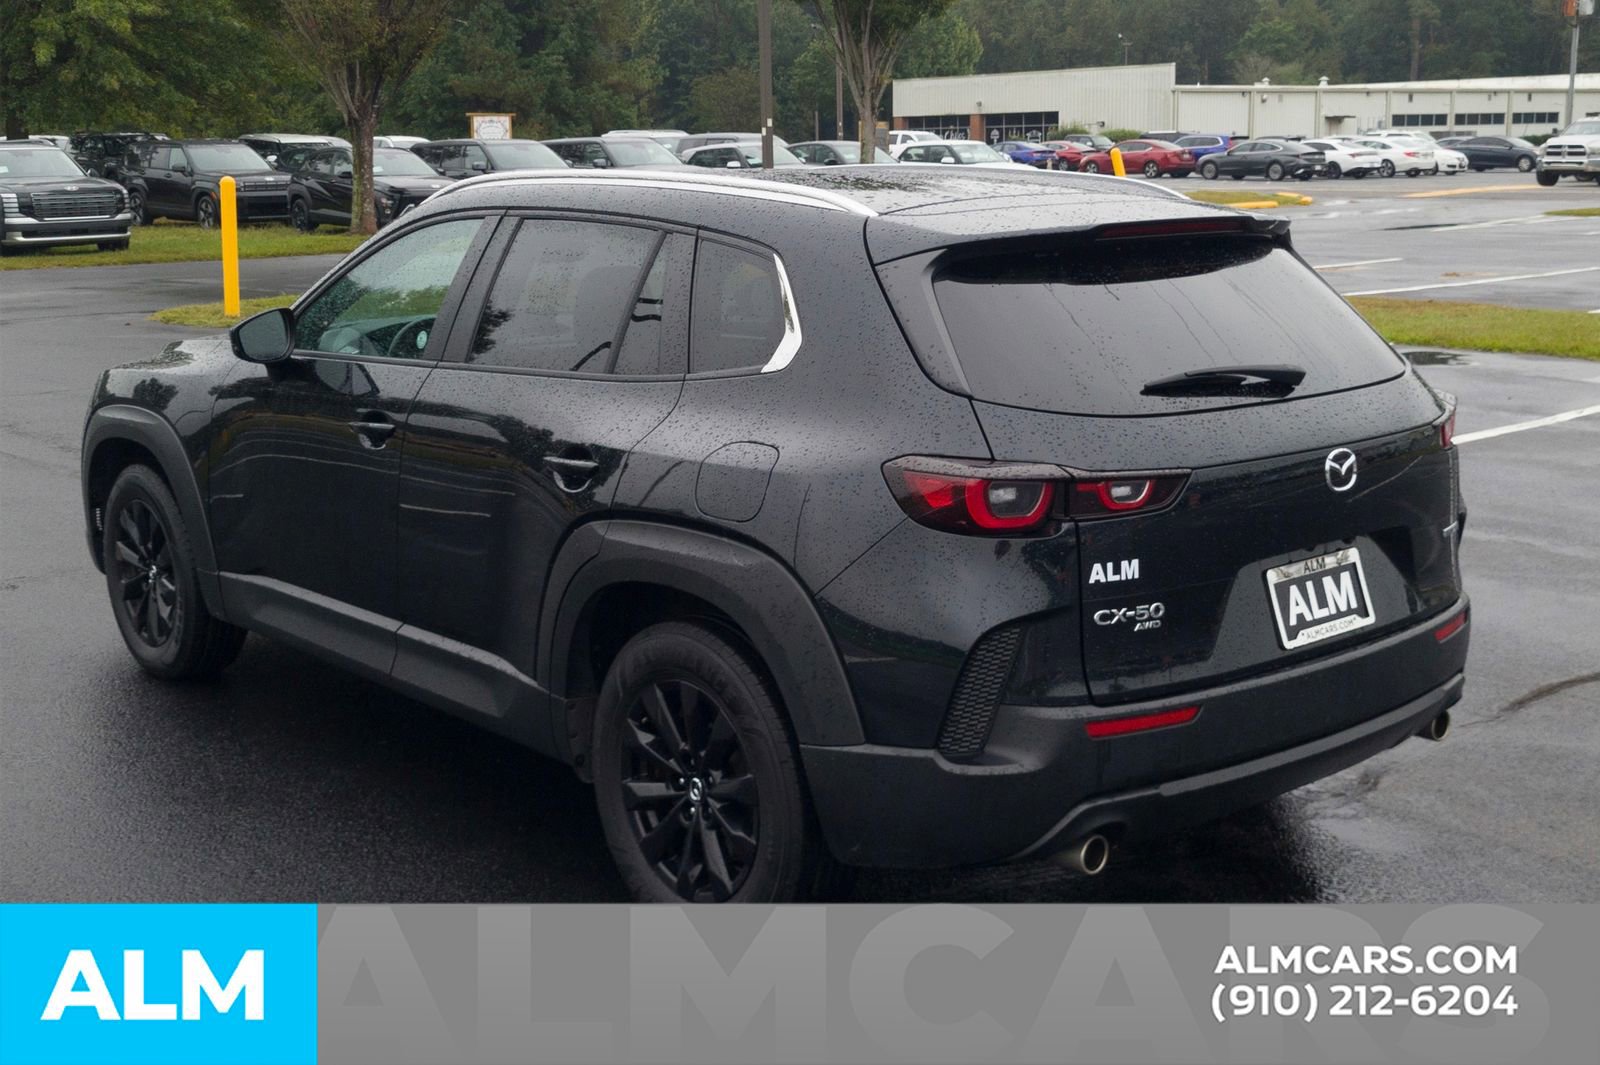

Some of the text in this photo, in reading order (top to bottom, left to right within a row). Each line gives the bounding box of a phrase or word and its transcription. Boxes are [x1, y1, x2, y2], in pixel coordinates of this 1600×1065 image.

[1088, 558, 1140, 584] ALM
[1303, 557, 1327, 574] ALM
[1289, 571, 1358, 626] ALM
[1093, 602, 1165, 626] CX-50
[1133, 620, 1162, 632] AWD
